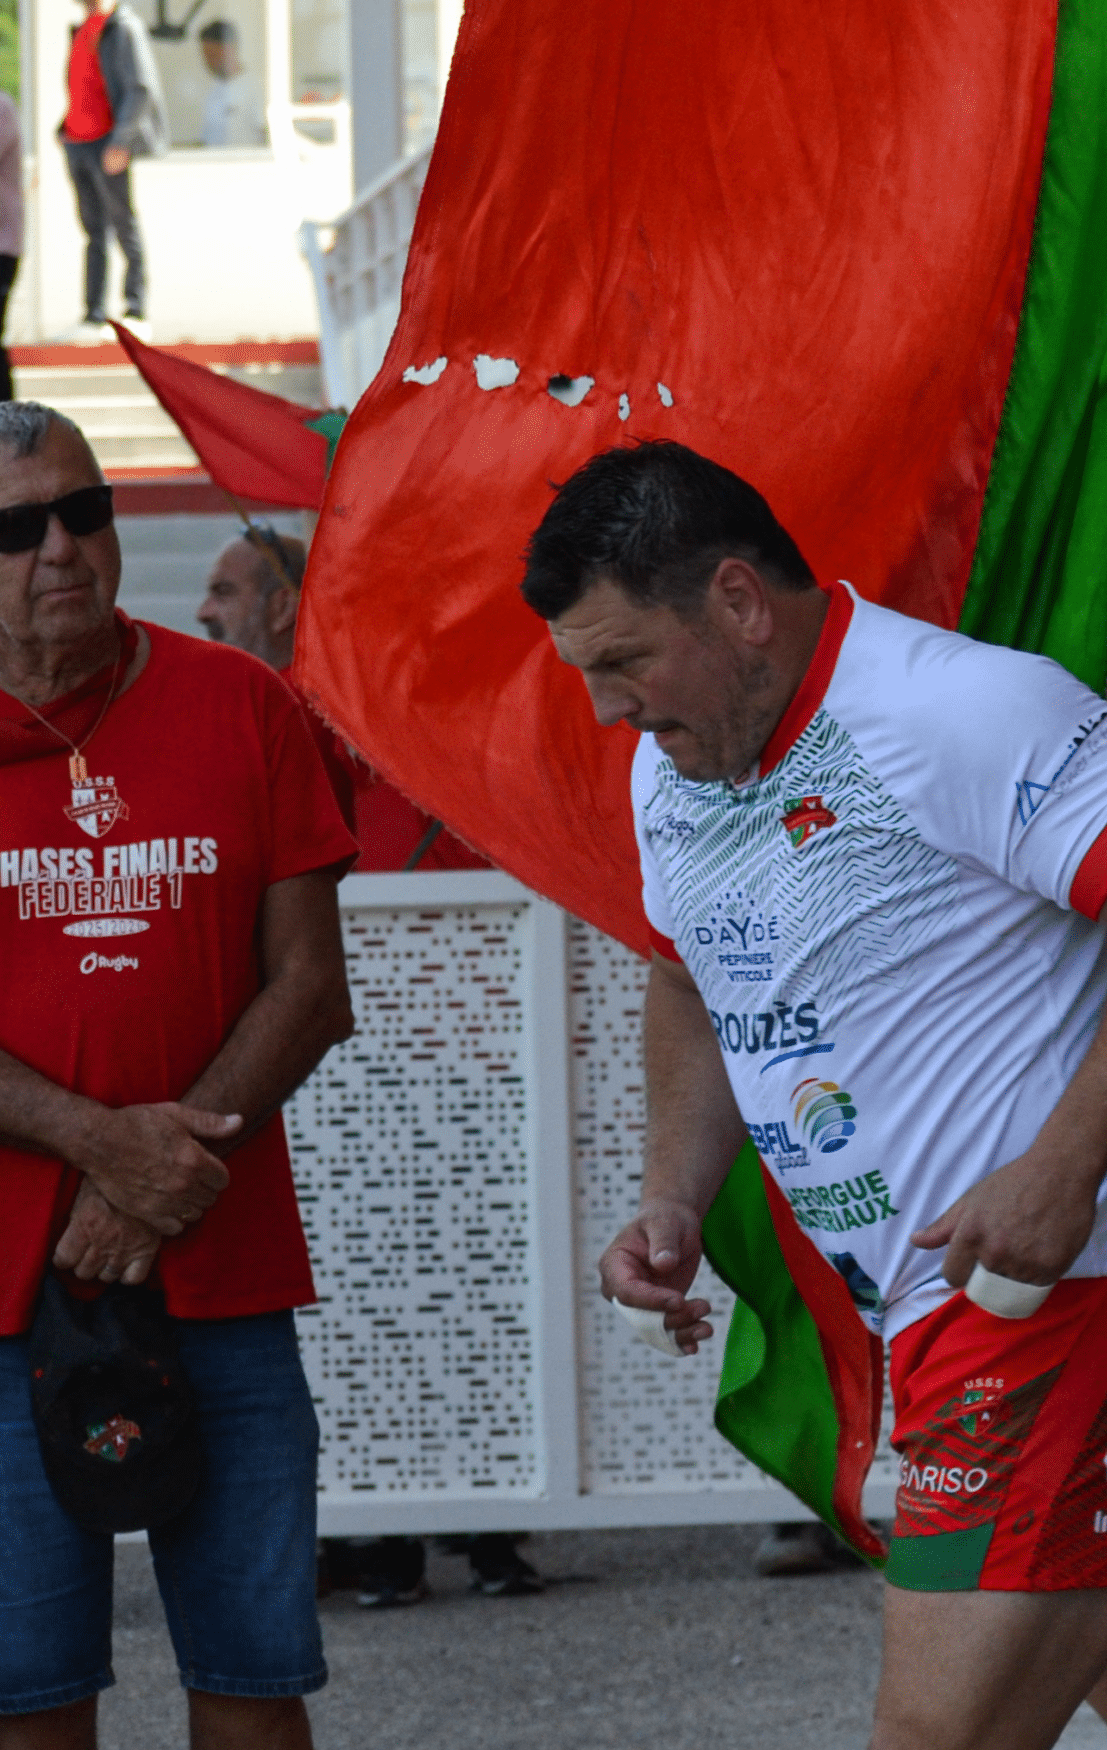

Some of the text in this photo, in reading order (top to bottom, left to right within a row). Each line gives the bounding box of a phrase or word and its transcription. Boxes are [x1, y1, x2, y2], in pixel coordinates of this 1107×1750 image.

[0, 837, 218, 887] HASES FINALES
[168, 867, 183, 909] 1
